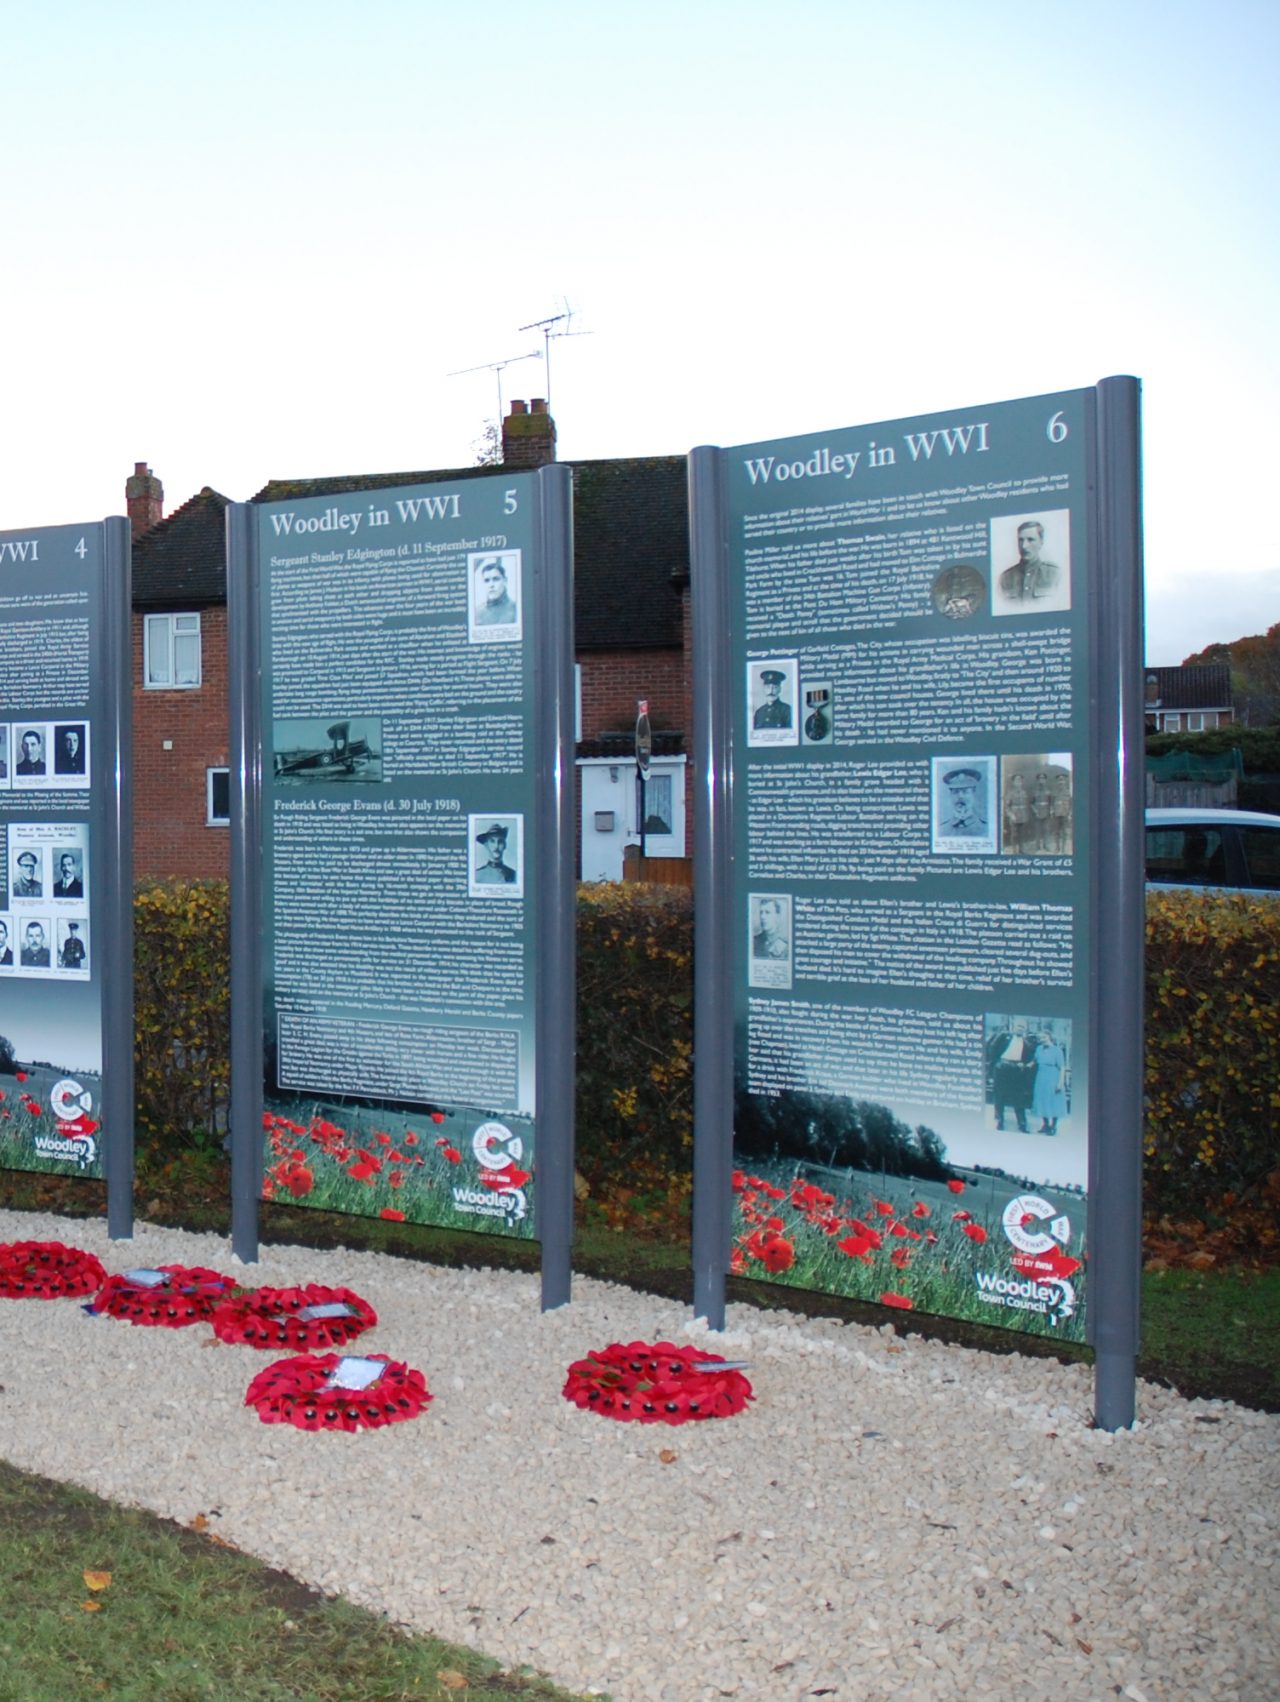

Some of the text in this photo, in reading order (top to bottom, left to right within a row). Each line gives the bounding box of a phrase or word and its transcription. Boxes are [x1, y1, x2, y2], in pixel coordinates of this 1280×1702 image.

[744, 410, 1068, 484] Woodley in WWI 6
[270, 488, 517, 536] Woodley in WWI 5
[74, 537, 88, 559] 4
[270, 534, 507, 568] Sergeant Stanley Edgington (d. 11 September 1917)
[274, 799, 460, 813] Frederick George Evans (d. 30 July 1918)
[35, 1136, 87, 1156] Woodley
[453, 1187, 516, 1211] Woodley
[454, 1202, 506, 1217] Town Council
[1009, 1257, 1024, 1266] LED
[1024, 1260, 1034, 1268] BY
[976, 1272, 1060, 1306] Woodley
[977, 1291, 1047, 1313] Town Council
